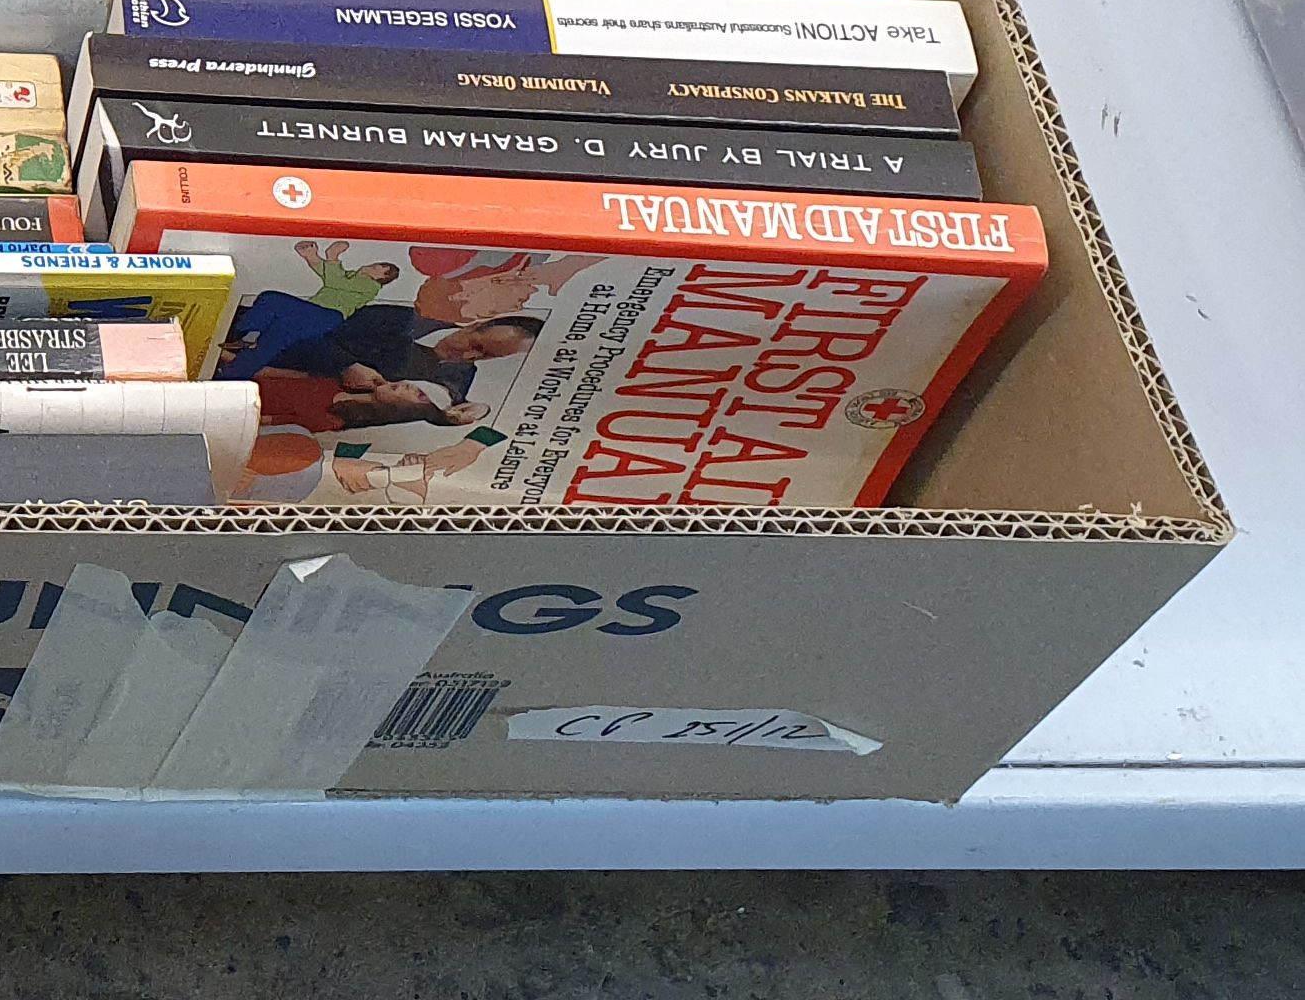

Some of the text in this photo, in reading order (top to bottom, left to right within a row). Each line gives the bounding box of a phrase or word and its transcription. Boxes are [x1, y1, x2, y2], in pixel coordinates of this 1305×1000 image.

[336, 8, 516, 30] YOSSI SEGELMAN
[557, 16, 941, 44] Take ACTION! Successful Australians share their secrets
[148, 58, 316, 78] Ginninderra Press
[256, 119, 904, 174] A TRIAL BY JURY D. GRAHAM BURNETT
[178, 166, 190, 203] COLLINS
[21, 256, 191, 269] MONEY FRIENDS
[6, 352, 48, 372] LEE
[556, 266, 675, 446] Emergency Procedures for
[721, 269, 929, 430] FIRST
[539, 367, 571, 407] Work
